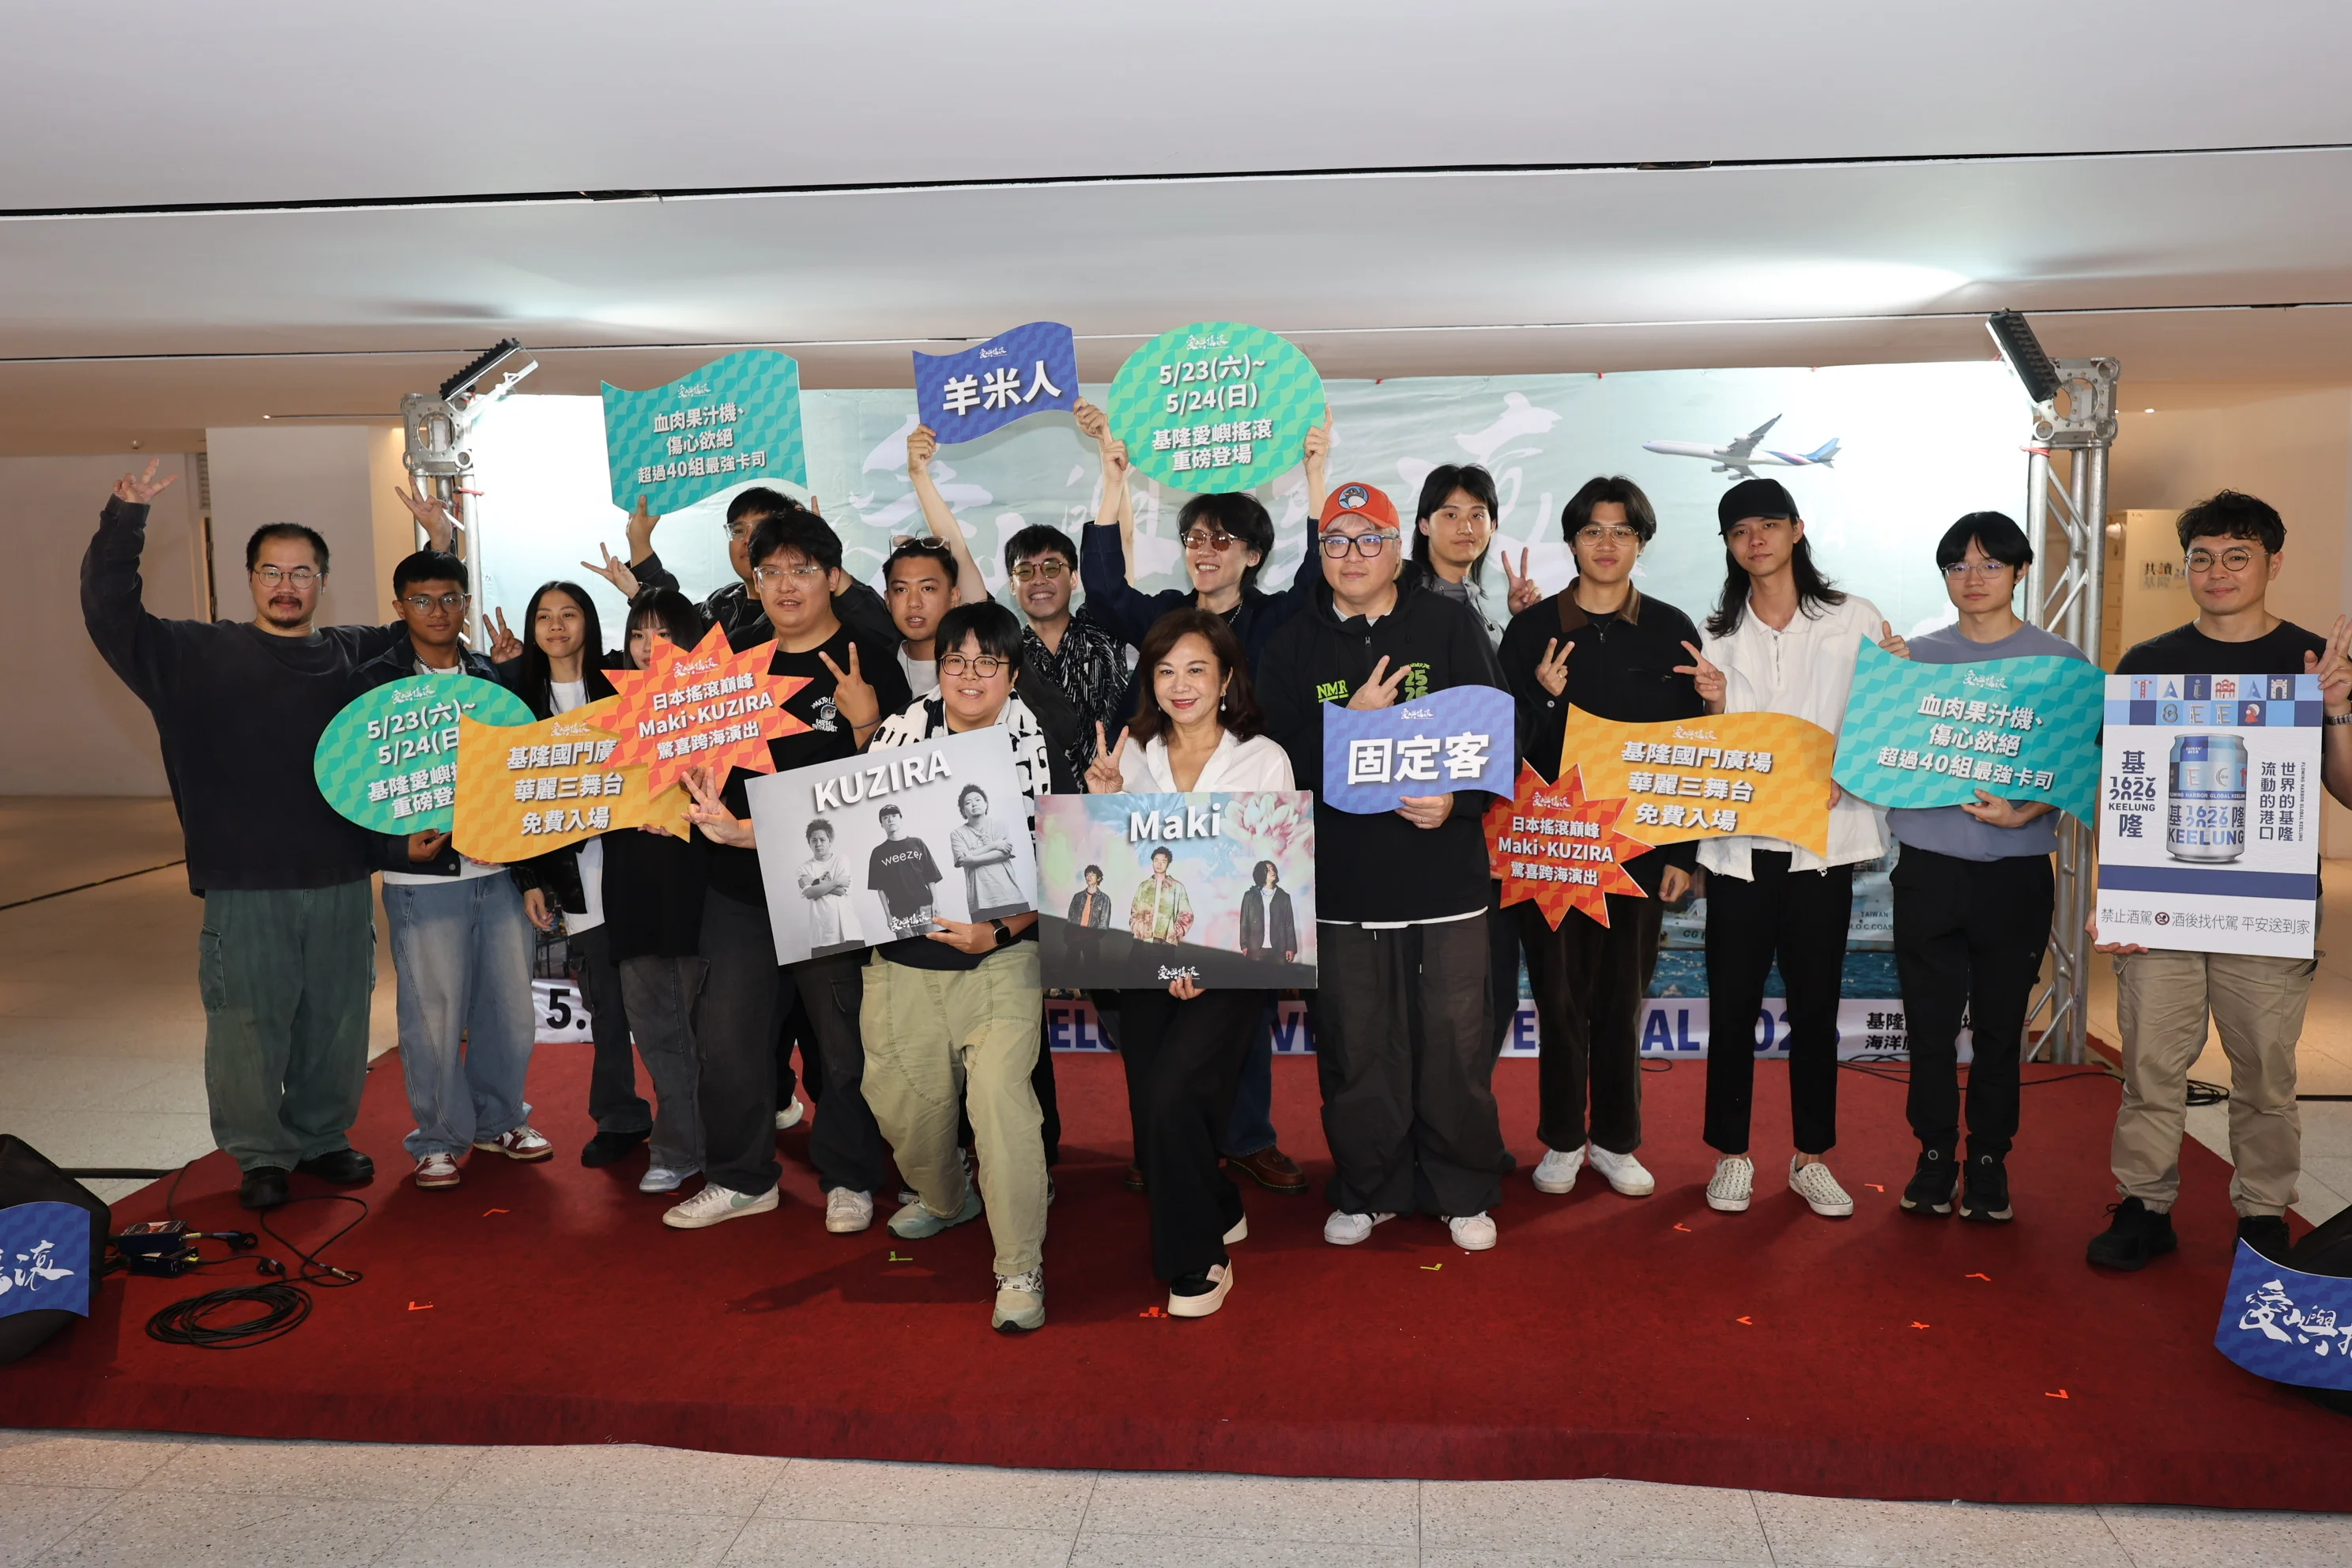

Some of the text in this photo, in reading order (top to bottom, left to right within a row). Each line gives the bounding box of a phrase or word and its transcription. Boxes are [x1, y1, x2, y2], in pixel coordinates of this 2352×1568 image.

[943, 360, 1061, 416] 羊米人
[1166, 383, 1259, 416] 5/24(日)
[666, 428, 734, 457] 傷心欲絕
[1152, 418, 1273, 450] 基隆愛嶼搖滾
[638, 450, 767, 484] 超過40組最強卡司
[1172, 444, 1253, 472] 重磅登場
[1316, 680, 1348, 699] NMR
[1404, 669, 1428, 686] 25
[656, 723, 760, 761] 驚喜跨海演出
[1928, 722, 2022, 758] 傷心欲絕
[1347, 731, 1491, 786] 固定客
[1620, 741, 1773, 774] 基隆國門廣場
[1877, 746, 2055, 791] 超過40組最強卡司
[2121, 750, 2146, 775] 基
[514, 771, 624, 803] 華麗三舞台
[814, 749, 953, 812] KUZIRA
[1627, 771, 1755, 802] 華麗三舞台
[2109, 802, 2156, 812] KEELUNG
[2259, 761, 2277, 841] 流動的港口
[2278, 761, 2296, 842] 世界的基隆
[521, 805, 610, 836] 免費入場
[1129, 803, 1222, 842] Maki
[1634, 802, 1737, 832] 免費入場
[2119, 813, 2143, 838] 隆
[2168, 827, 2245, 846] KEELUNG
[880, 850, 923, 867] weezer
[1510, 860, 1599, 887] 驚喜跨海演出
[2101, 907, 2310, 935] 禁止酒駕 酒後找代駕 平安送到家
